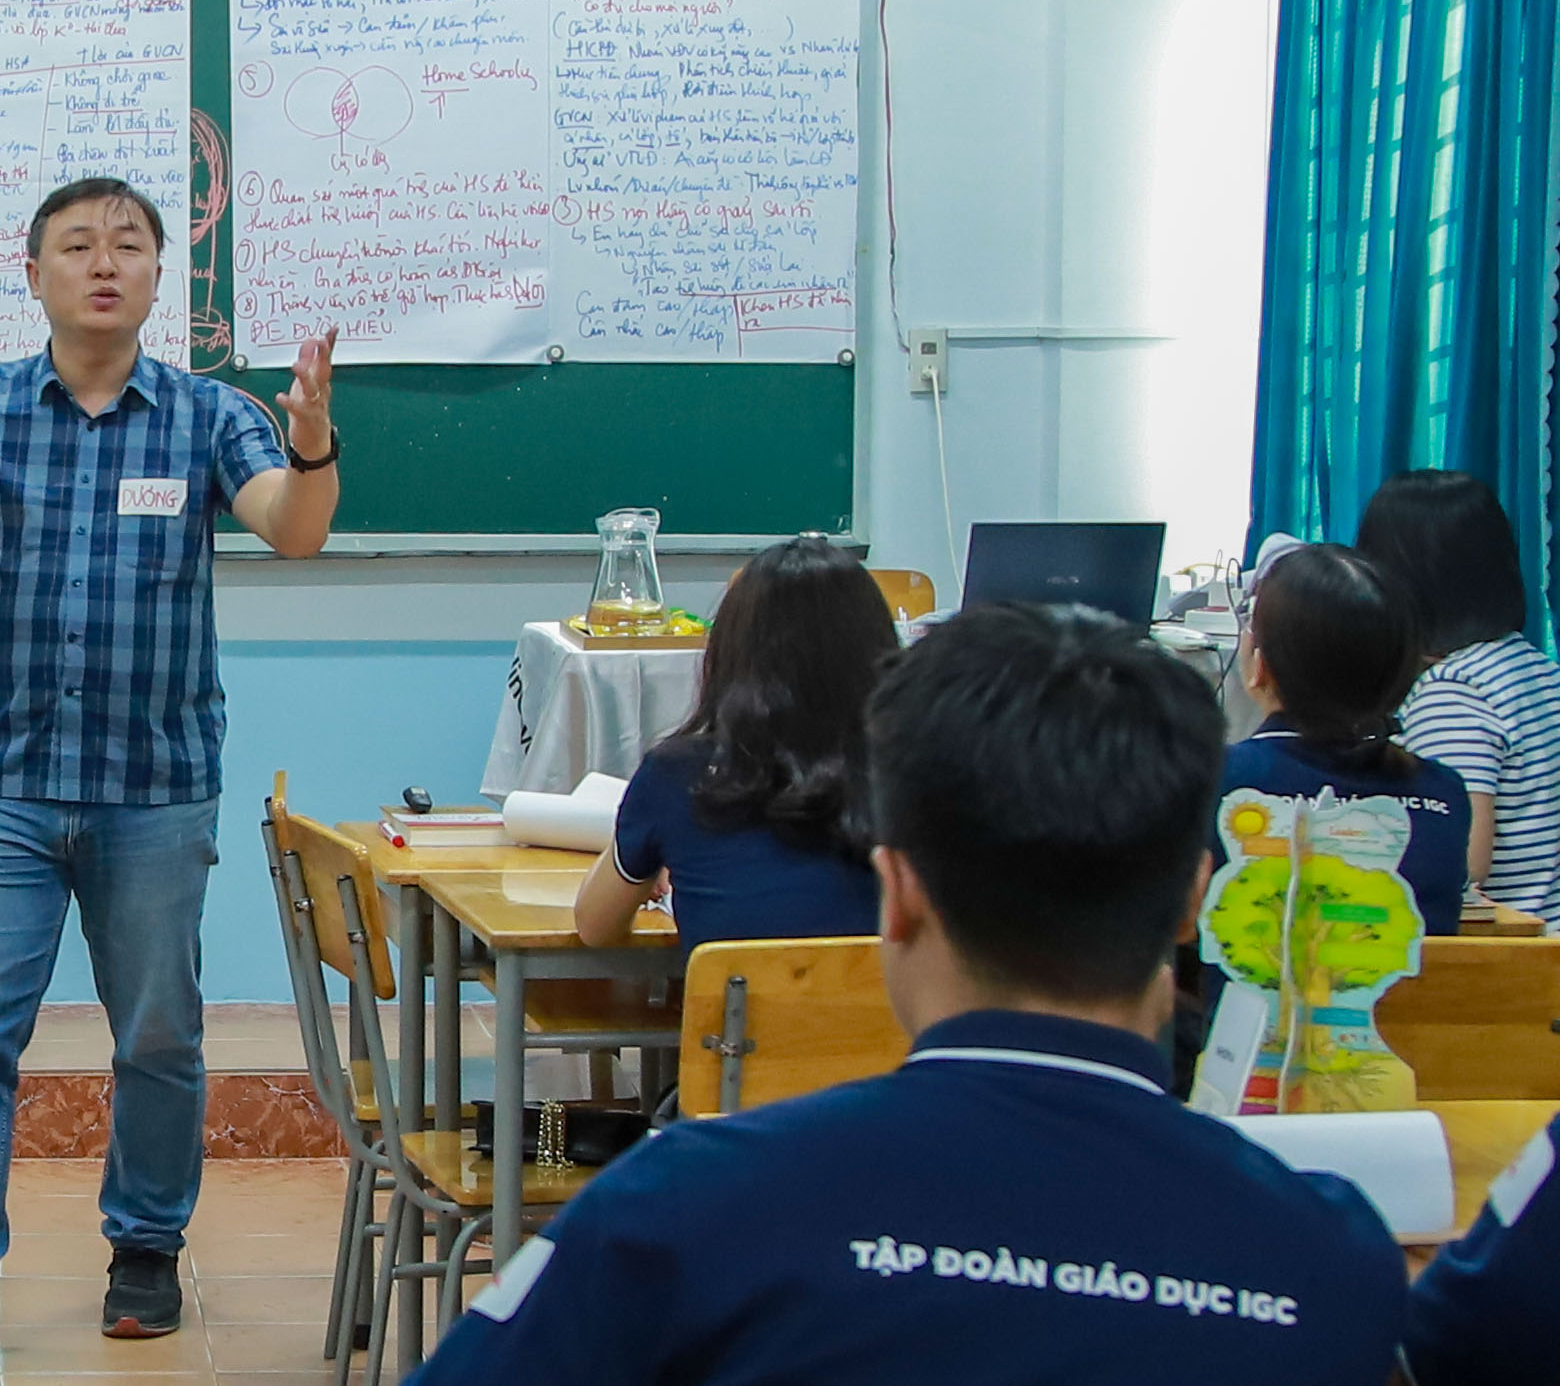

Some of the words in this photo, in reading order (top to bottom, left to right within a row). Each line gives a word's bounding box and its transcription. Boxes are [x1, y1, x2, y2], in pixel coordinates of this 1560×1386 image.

[1423, 796, 1450, 814] IGC
[850, 1236, 928, 1278] TẬP
[932, 1246, 1048, 1288] ĐOÀN
[1054, 1261, 1150, 1303] GIÁO
[1155, 1276, 1233, 1315] DỤC
[1238, 1289, 1299, 1325] IGC
